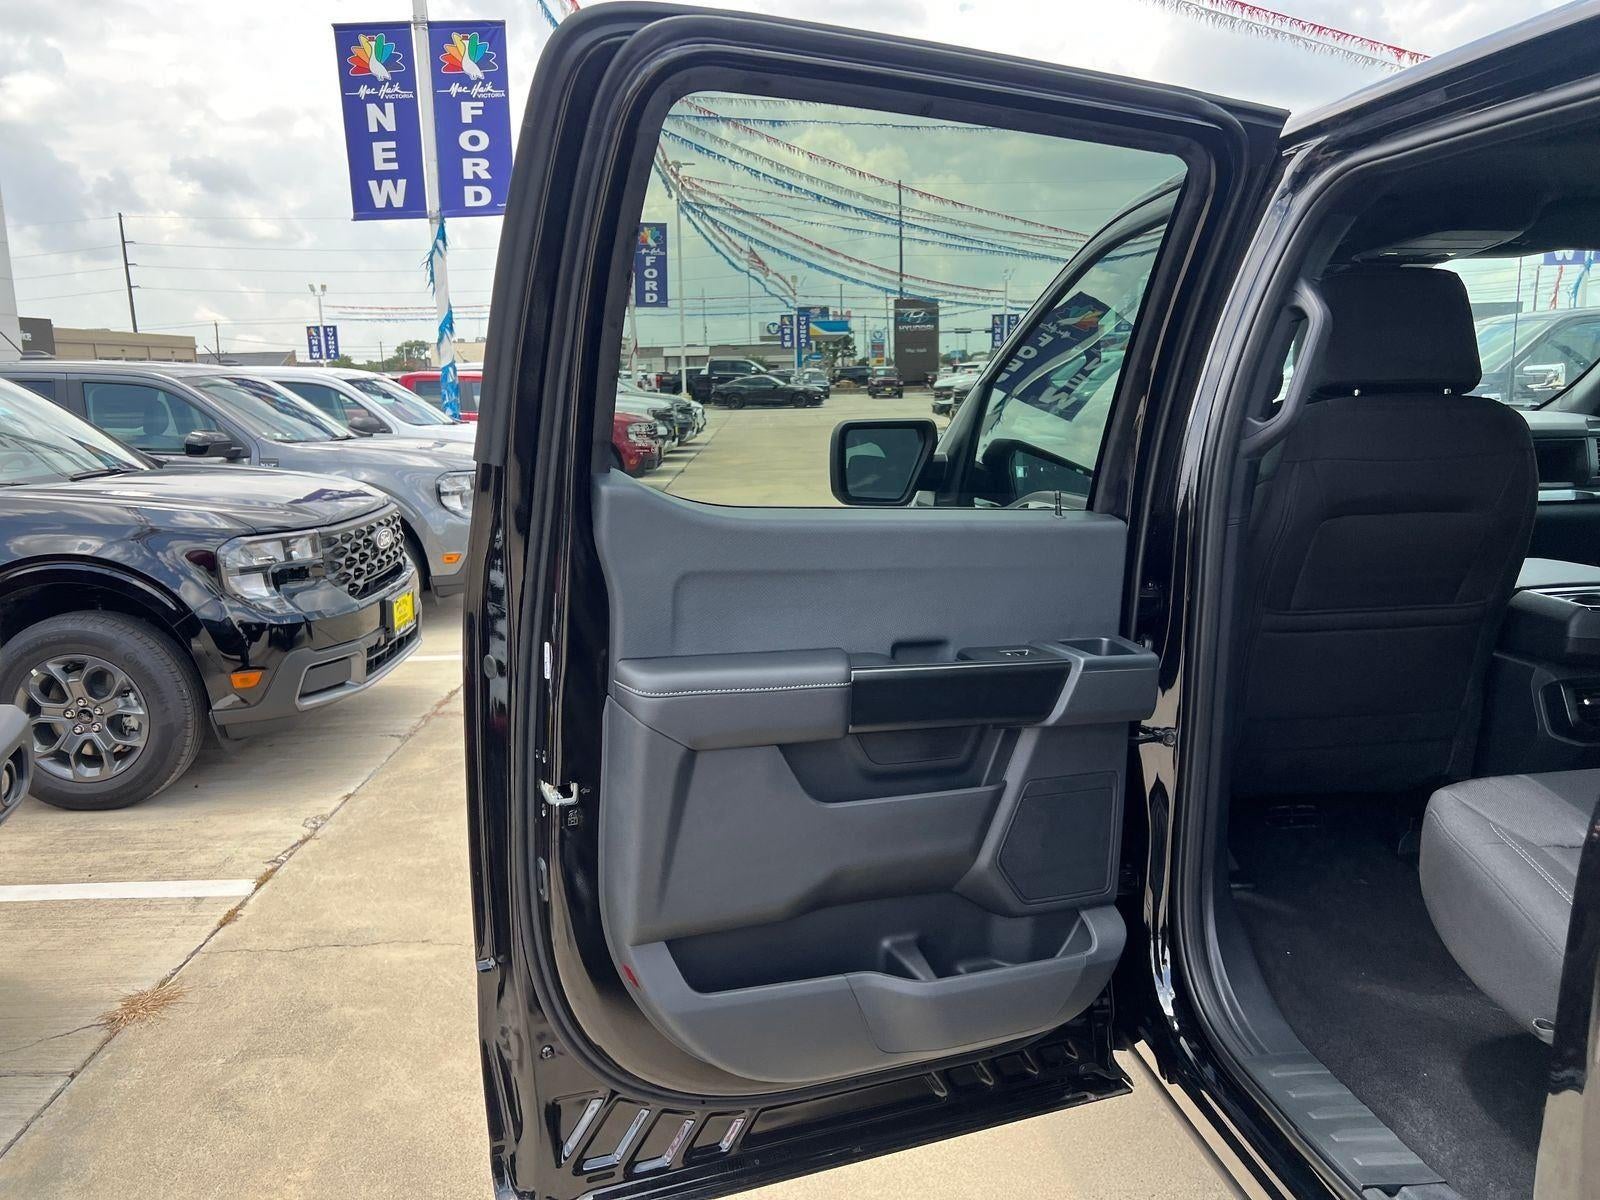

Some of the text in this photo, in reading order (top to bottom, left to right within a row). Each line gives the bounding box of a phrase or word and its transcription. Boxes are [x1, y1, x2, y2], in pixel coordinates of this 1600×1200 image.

[357, 81, 402, 99] Mac Haik
[449, 81, 495, 97] Mac Haik
[366, 102, 407, 209] NEW
[458, 101, 492, 207] FORD
[643, 256, 658, 303] FORD
[783, 328, 793, 348] NEW
[311, 339, 320, 358] NEW
